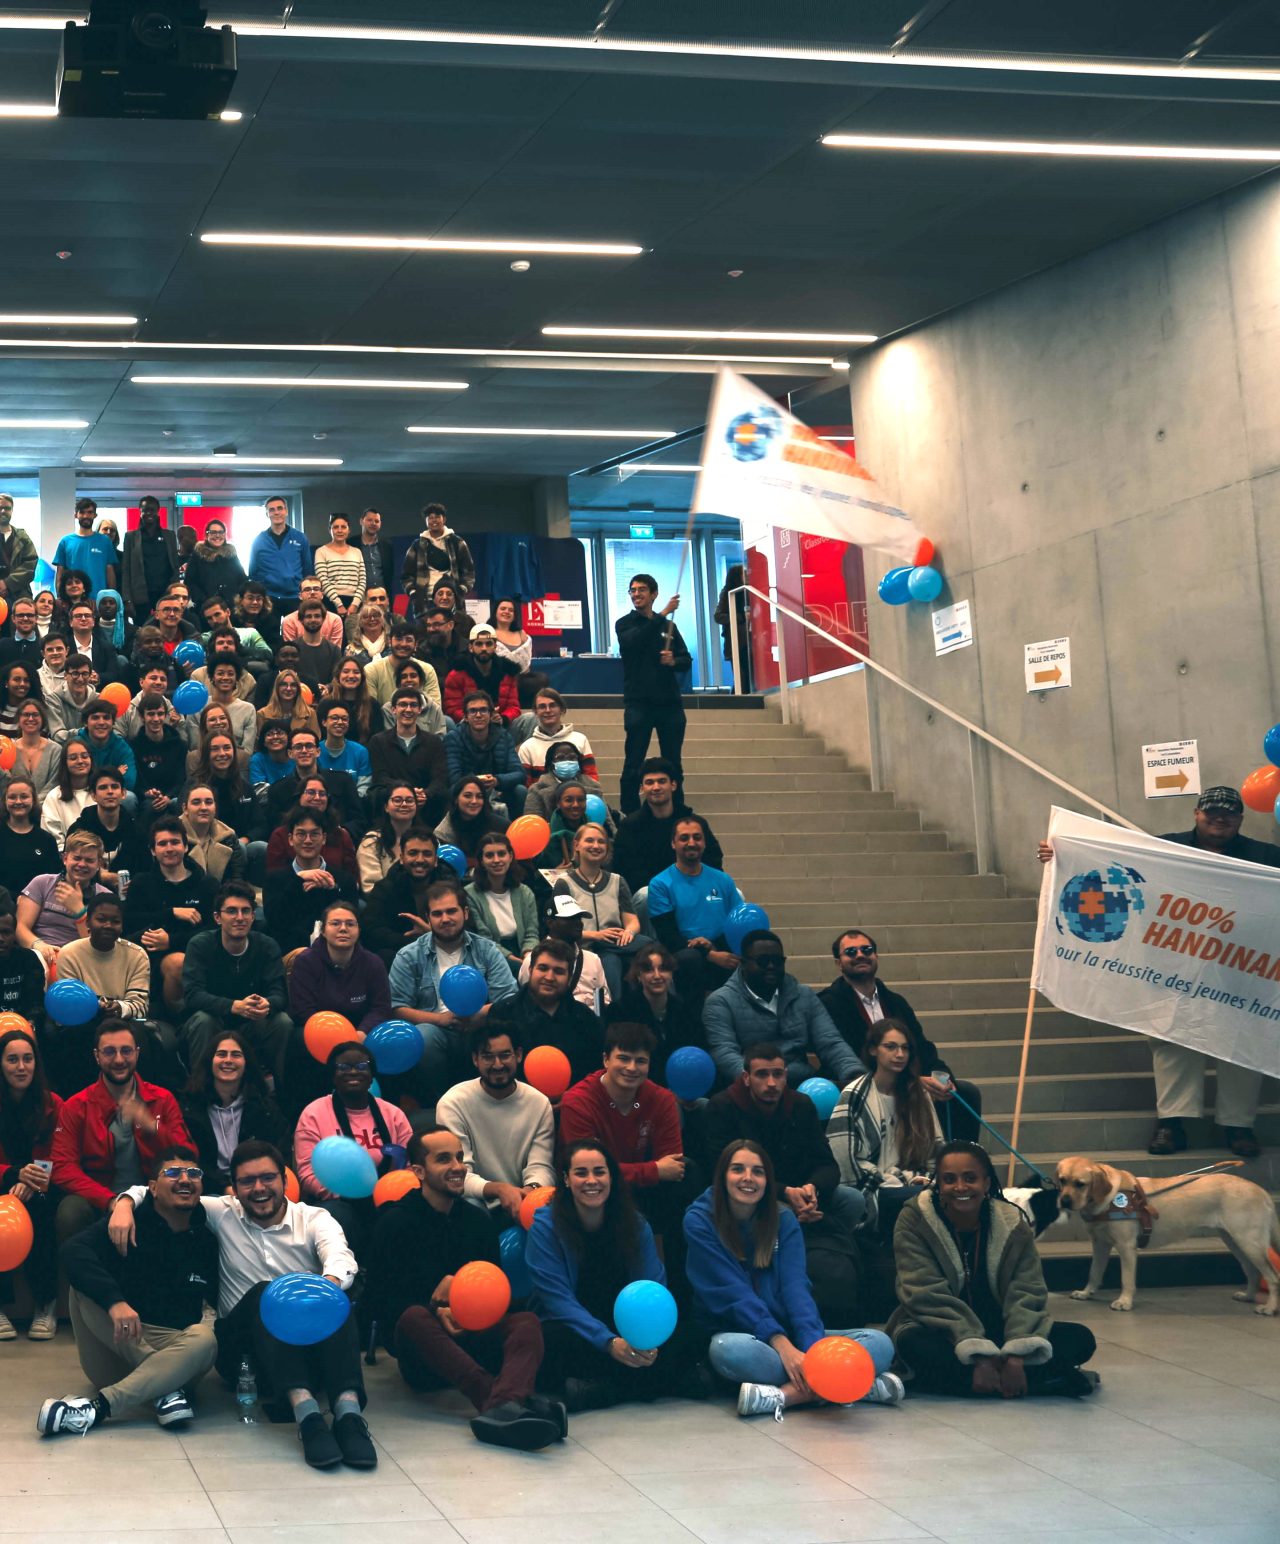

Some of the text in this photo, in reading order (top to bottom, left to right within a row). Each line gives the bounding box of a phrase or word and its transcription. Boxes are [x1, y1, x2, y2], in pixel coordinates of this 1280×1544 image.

[1028, 656, 1042, 664] SALLE
[1050, 652, 1065, 661] REPOS
[1147, 757, 1194, 767] ESPACE FUMEUR
[1156, 893, 1237, 934] 100%
[1055, 944, 1082, 963] our
[1083, 950, 1098, 967] la
[1102, 958, 1162, 985] réussite
[1165, 974, 1190, 993] des
[1191, 982, 1247, 1010] jeunes
